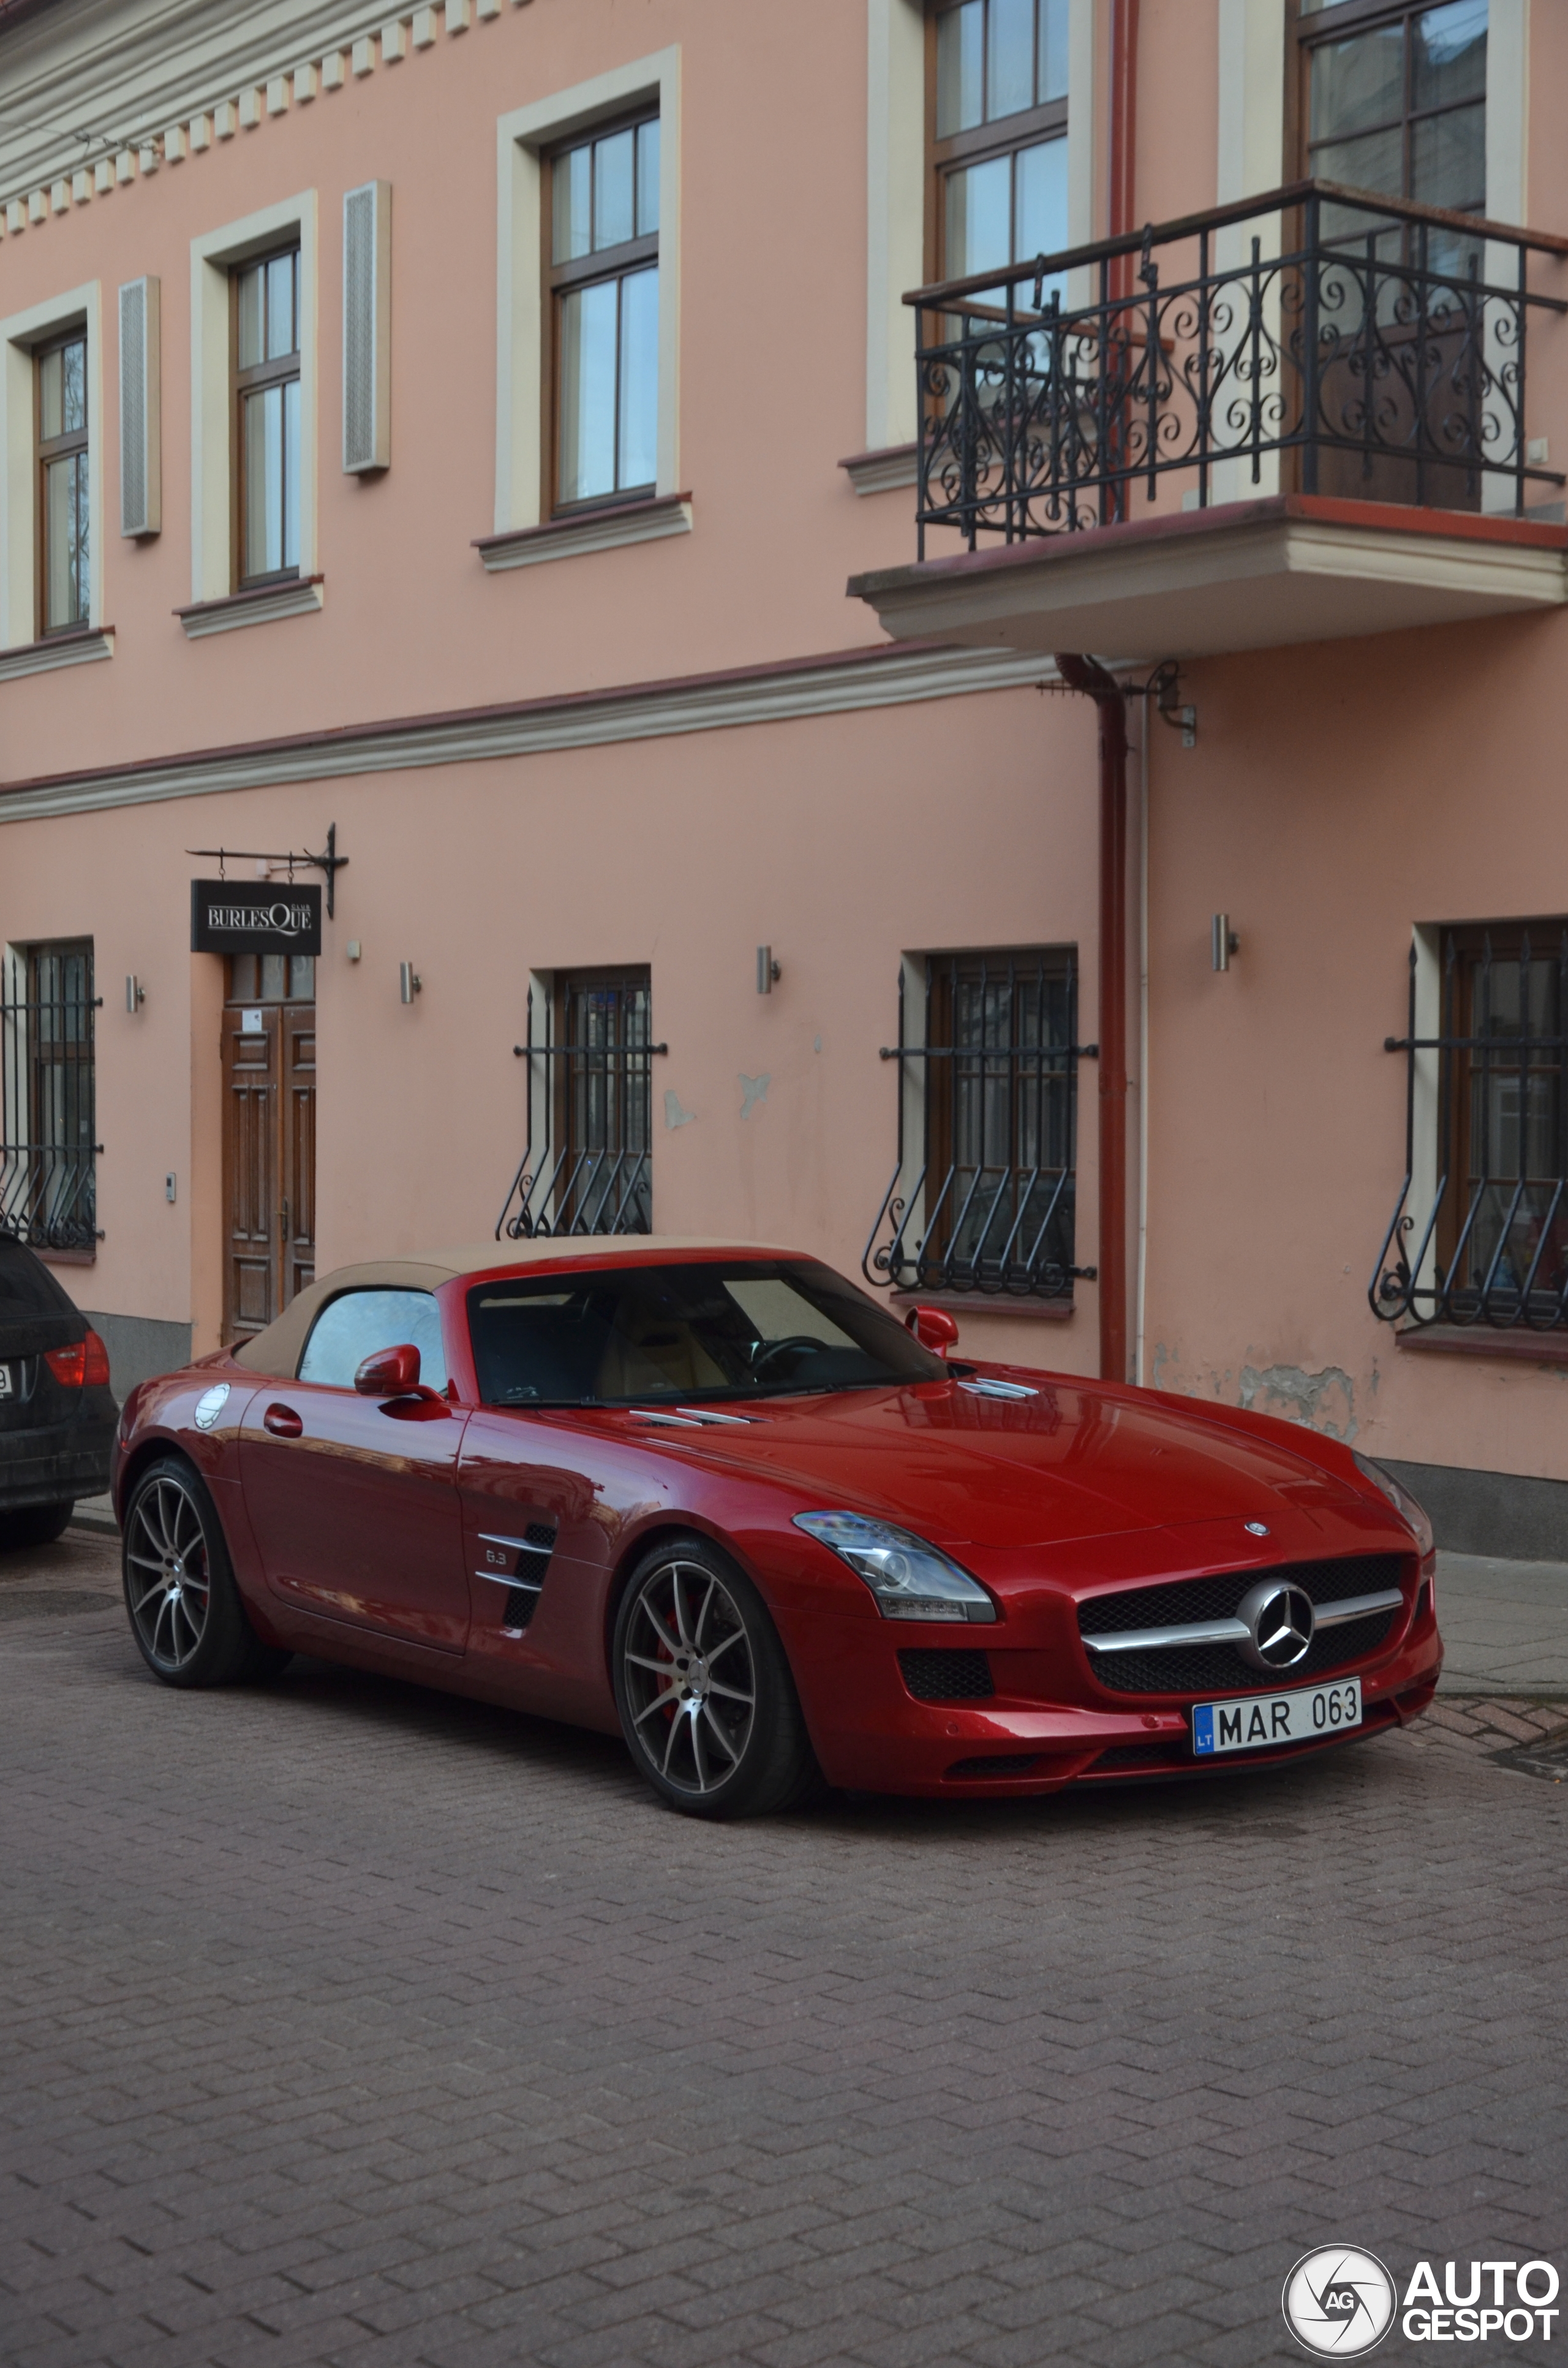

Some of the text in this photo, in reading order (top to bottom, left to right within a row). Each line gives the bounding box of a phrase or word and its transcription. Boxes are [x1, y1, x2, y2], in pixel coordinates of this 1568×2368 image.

[208, 903, 312, 937] BURLESQUE
[486, 1549, 507, 1565] 6.3
[1219, 1686, 1357, 1746] MAR 063
[1198, 1734, 1212, 1747] LT
